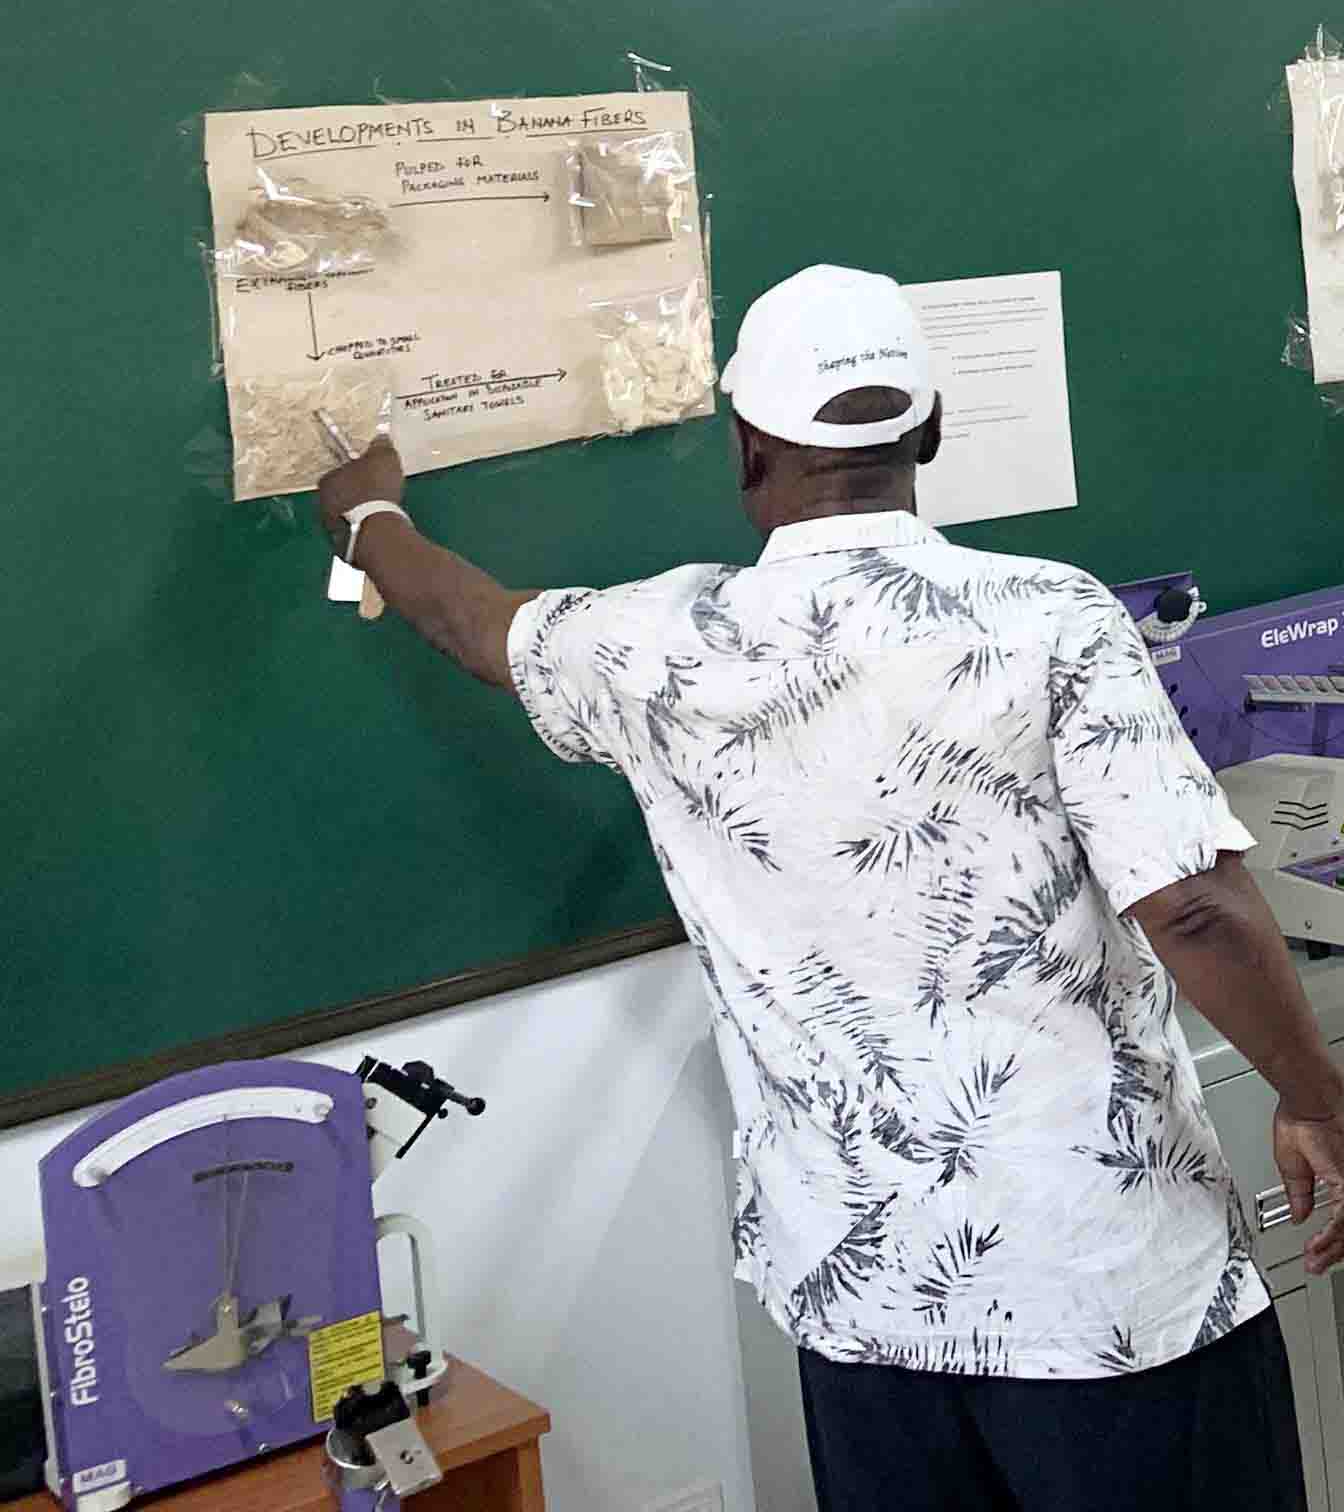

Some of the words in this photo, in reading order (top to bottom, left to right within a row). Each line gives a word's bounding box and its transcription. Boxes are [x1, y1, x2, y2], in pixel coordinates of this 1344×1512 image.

[246, 118, 434, 159] DEVELOPMENTS
[456, 116, 476, 135] IN
[497, 110, 573, 133] BANANA
[581, 106, 647, 129] FIBERS
[477, 169, 540, 185] MATERIALS
[420, 371, 482, 392] TREATED
[1260, 617, 1339, 649] EleWrap
[60, 1276, 99, 1406] FibroStelo
